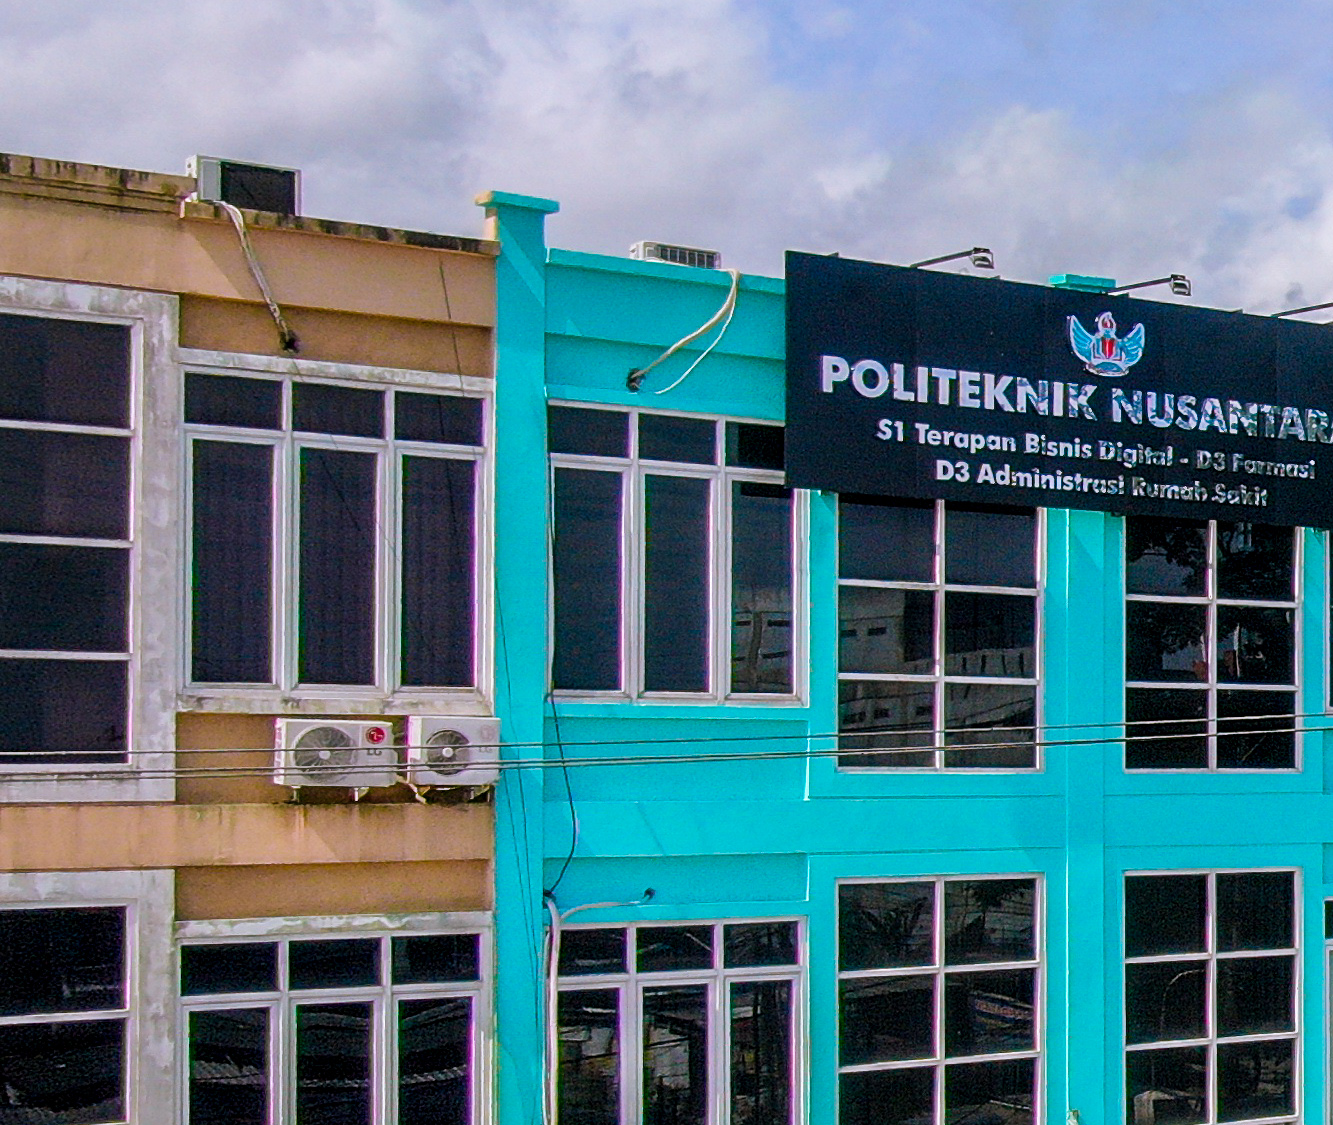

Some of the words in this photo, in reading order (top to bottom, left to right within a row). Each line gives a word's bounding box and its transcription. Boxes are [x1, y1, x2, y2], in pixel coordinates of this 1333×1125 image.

[821, 354, 1098, 422] POLITEKNIK
[876, 417, 905, 442] S1
[915, 422, 1016, 453] Terapan
[1023, 432, 1092, 459] Bisnis
[1098, 439, 1173, 470] Digital
[1195, 449, 1226, 472] D3
[1231, 453, 1316, 480] Farmasi
[936, 458, 970, 483] D3
[977, 466, 1125, 495] Administrasi
[1132, 475, 1208, 502] Rumah
[1213, 481, 1268, 508] Sakit
